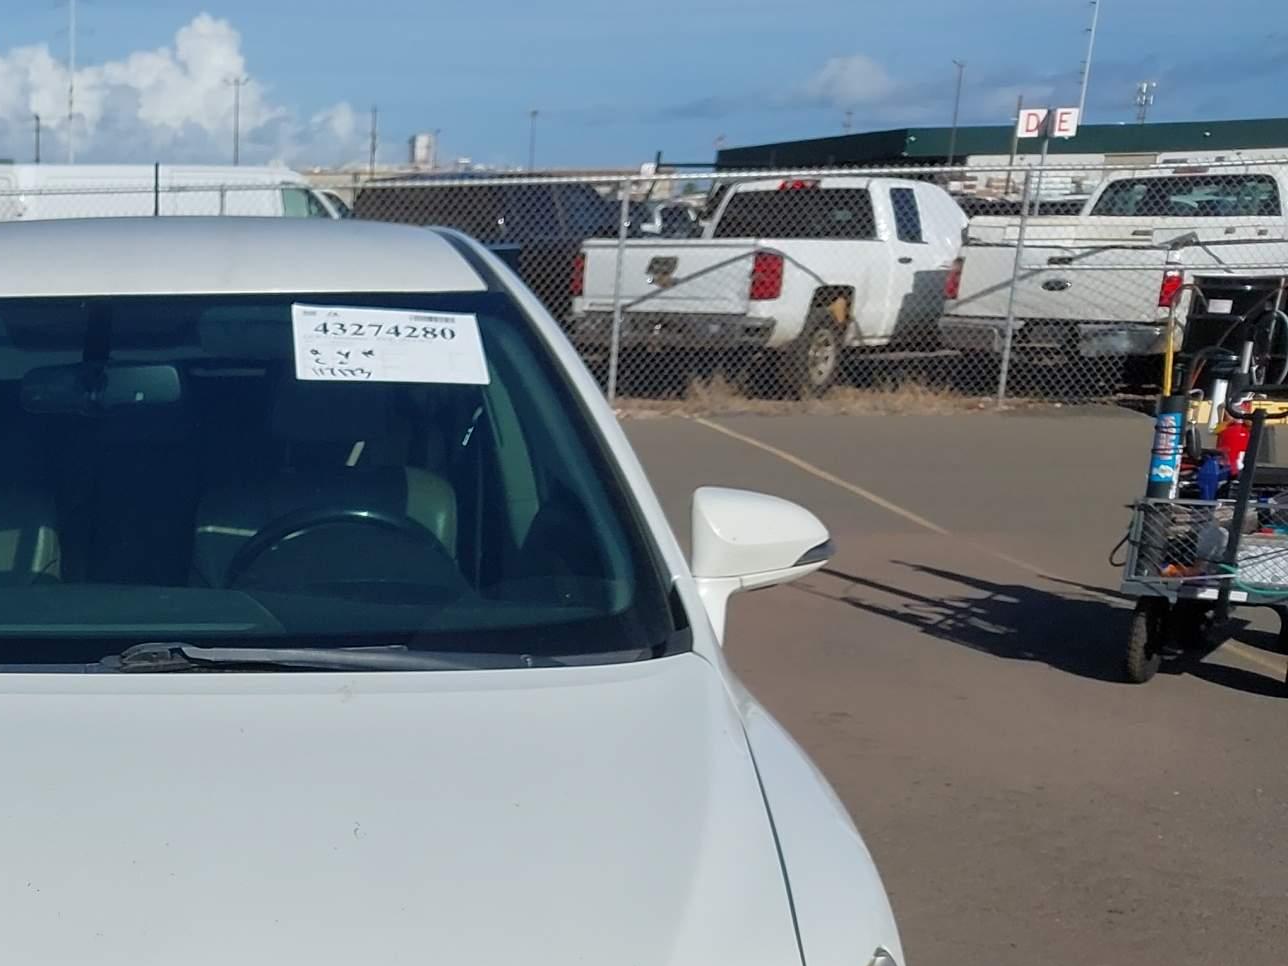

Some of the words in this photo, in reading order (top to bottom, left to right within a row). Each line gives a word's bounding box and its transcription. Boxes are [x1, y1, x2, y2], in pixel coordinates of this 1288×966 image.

[1025, 113, 1040, 132] D
[1058, 112, 1072, 131] E
[313, 322, 456, 340] 43274280
